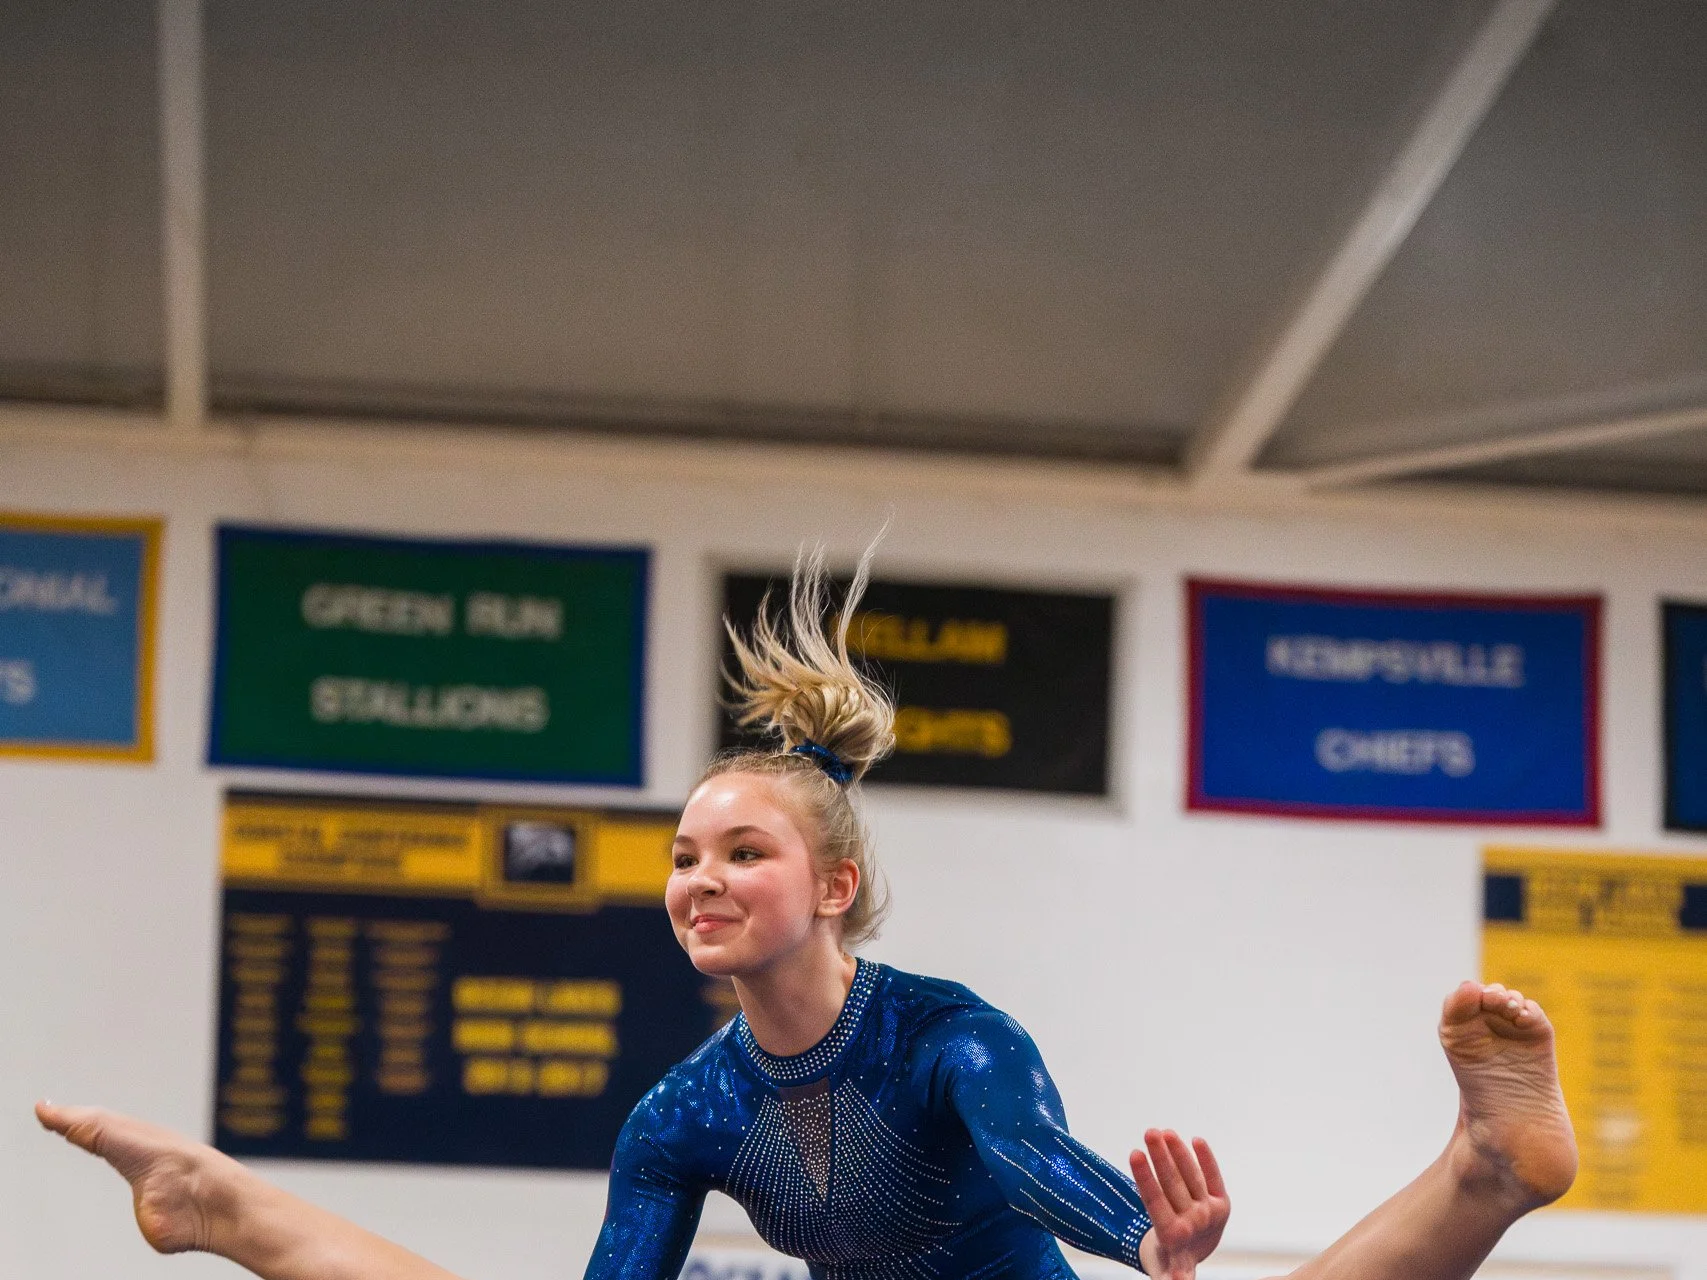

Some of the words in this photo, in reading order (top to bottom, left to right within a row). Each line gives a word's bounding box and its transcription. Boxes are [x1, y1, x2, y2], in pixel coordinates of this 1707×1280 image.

[303, 583, 454, 636] GREEN
[465, 592, 563, 641] RUN
[1266, 635, 1525, 689] KEMPSVILLE
[310, 675, 550, 733] STALLIONS
[1316, 728, 1477, 778] CHIEFS
